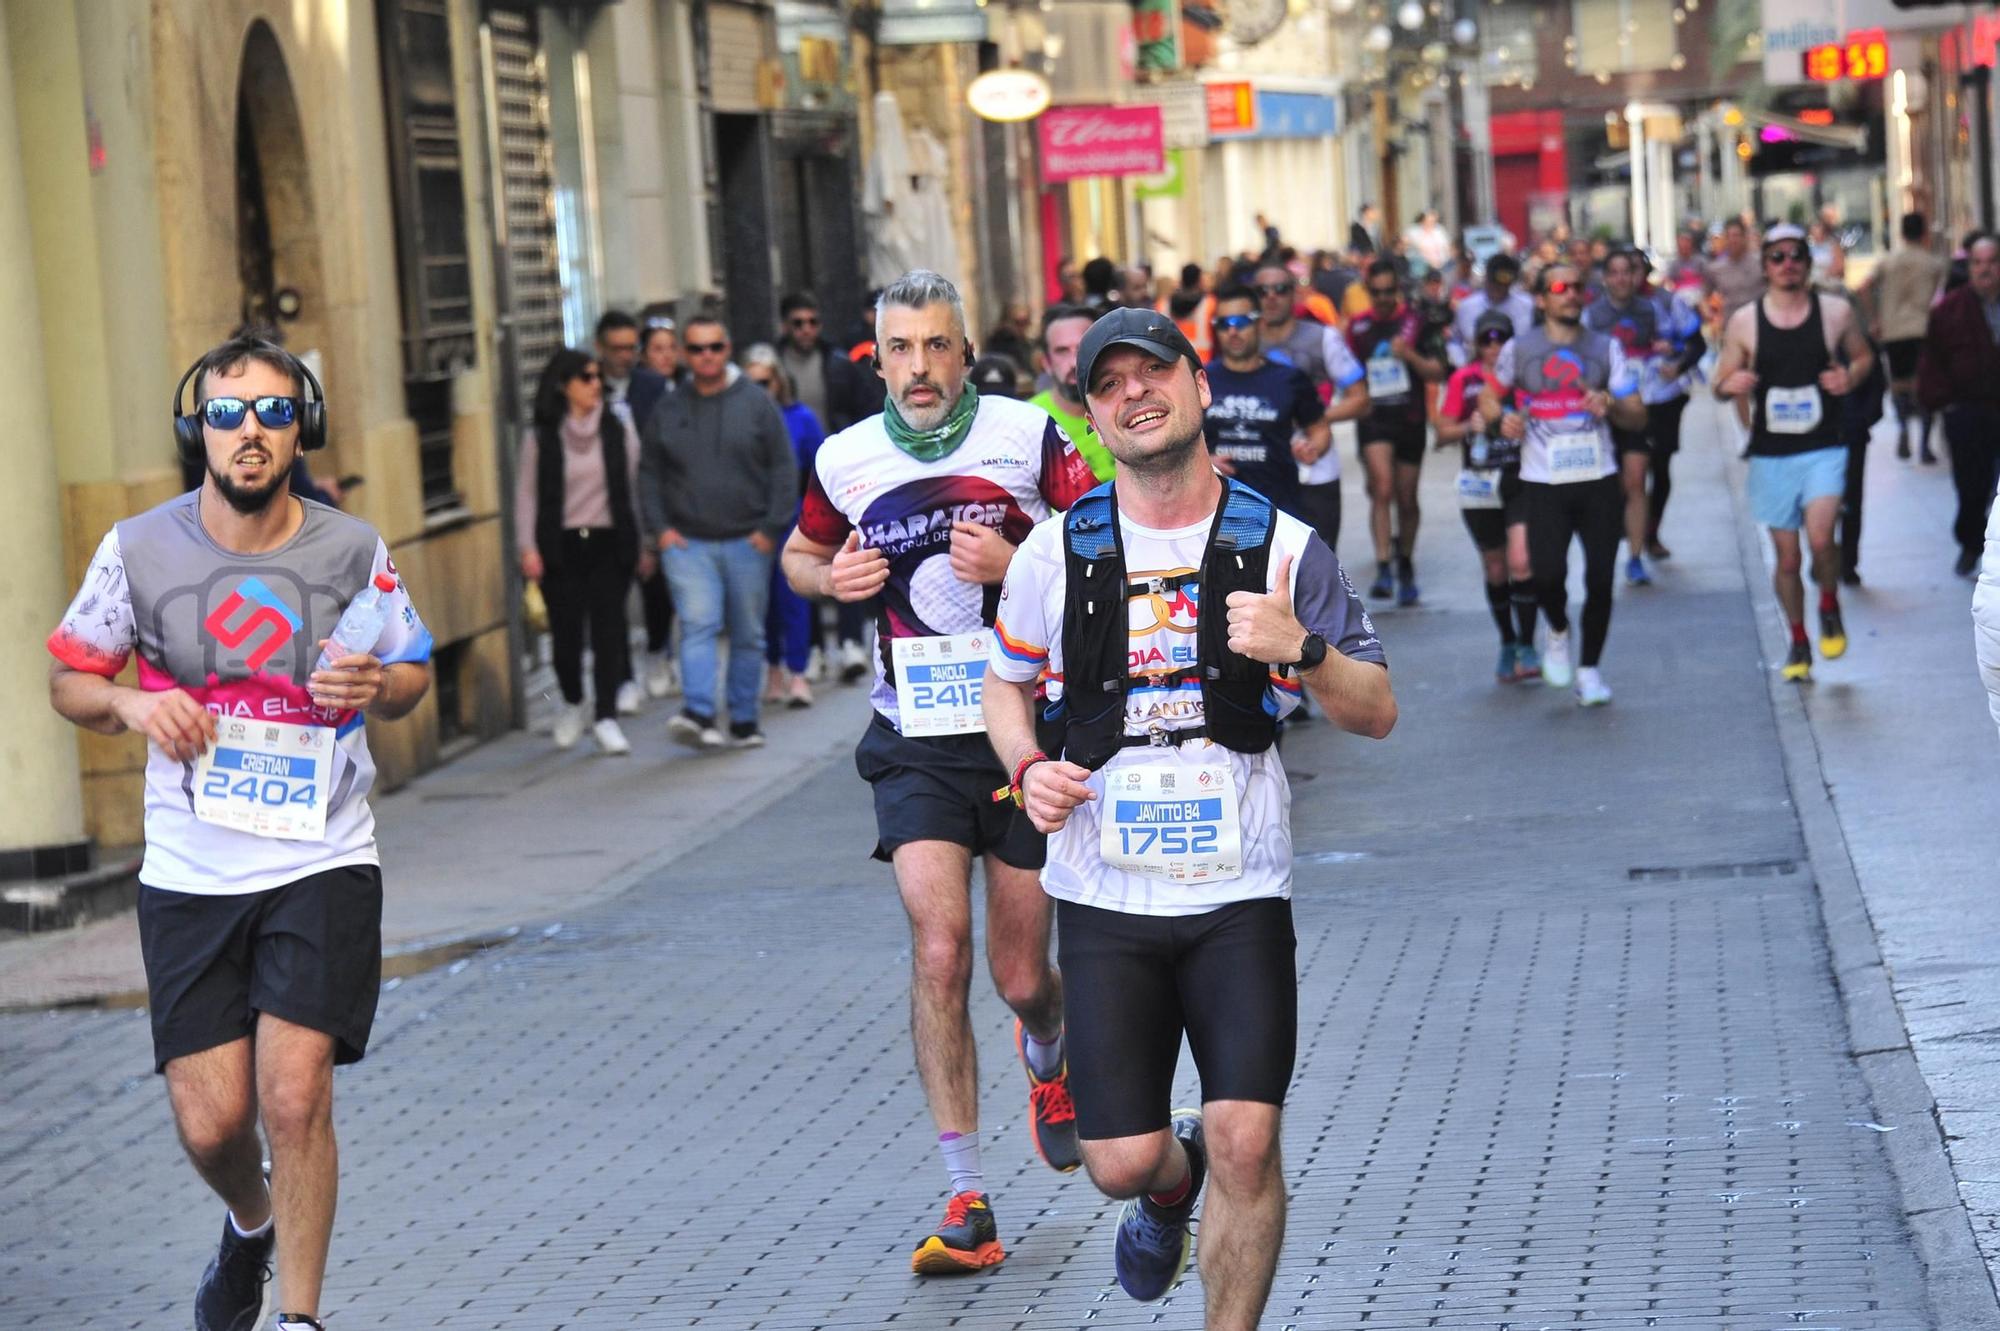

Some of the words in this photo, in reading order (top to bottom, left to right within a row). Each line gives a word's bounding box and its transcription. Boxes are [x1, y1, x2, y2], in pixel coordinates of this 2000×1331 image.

[930, 664, 967, 682] PAKOLO
[240, 752, 291, 777] CRISTIAN
[203, 770, 317, 809] 2404
[1136, 802, 1182, 823] JAVITTO
[1184, 802, 1200, 821] 84
[1118, 824, 1218, 855] 1752
